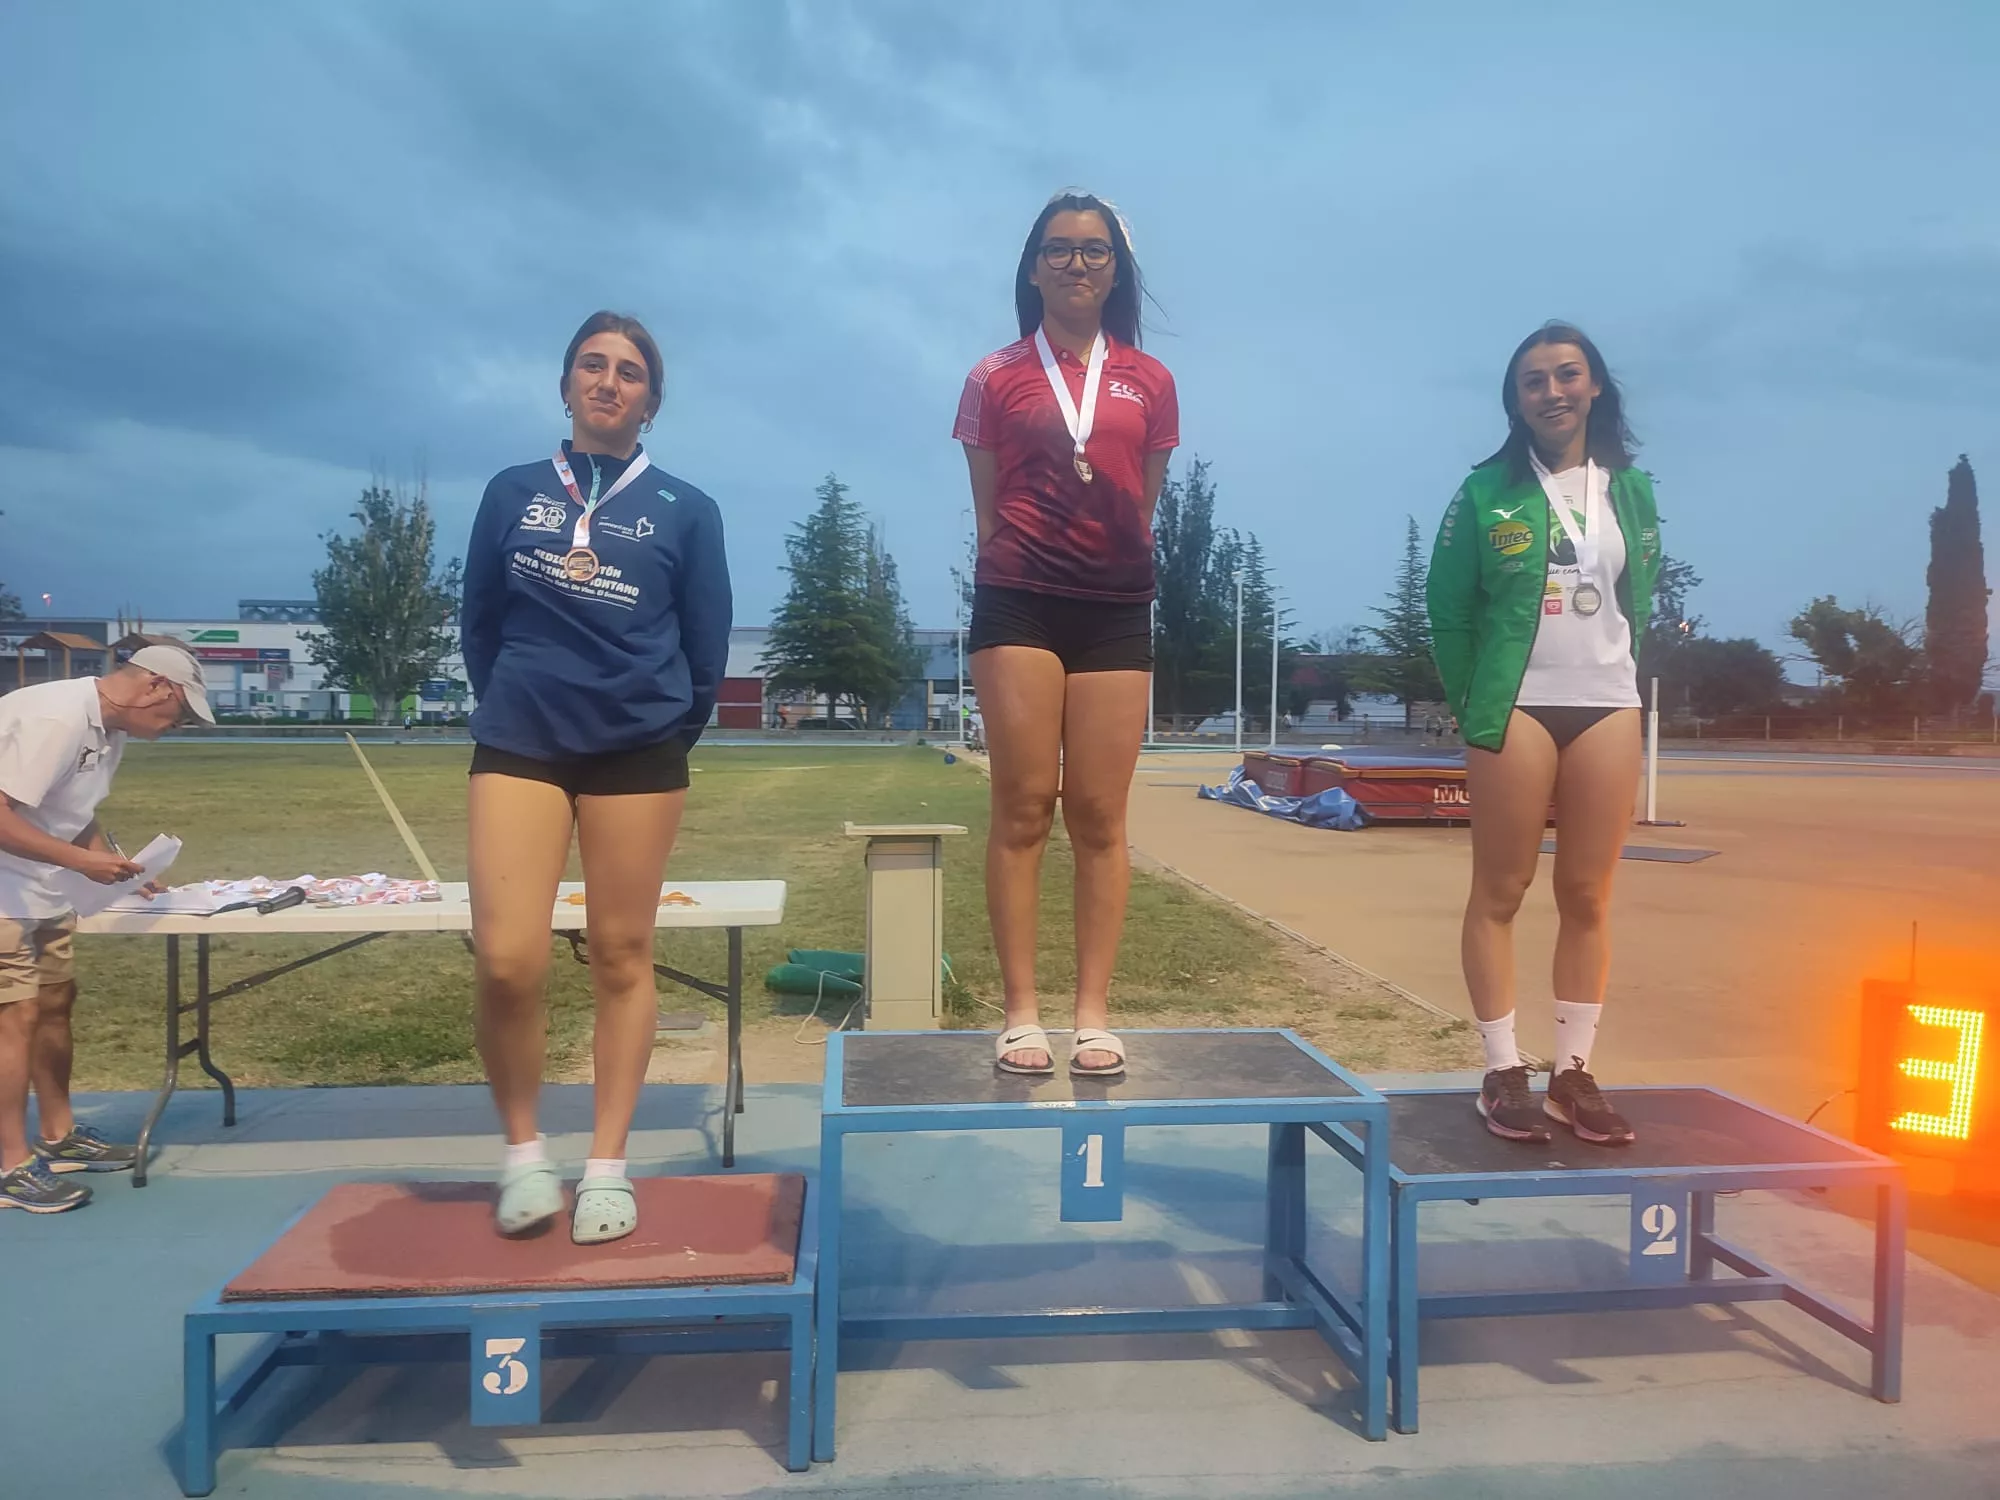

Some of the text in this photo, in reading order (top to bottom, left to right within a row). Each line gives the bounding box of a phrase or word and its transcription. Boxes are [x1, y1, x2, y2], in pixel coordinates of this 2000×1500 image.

[514, 552, 539, 569] RUTA
[1889, 1004, 1985, 1140] 3
[1077, 1134, 1105, 1187] 1
[1642, 1204, 1677, 1256] 2
[483, 1338, 528, 1394] 3
